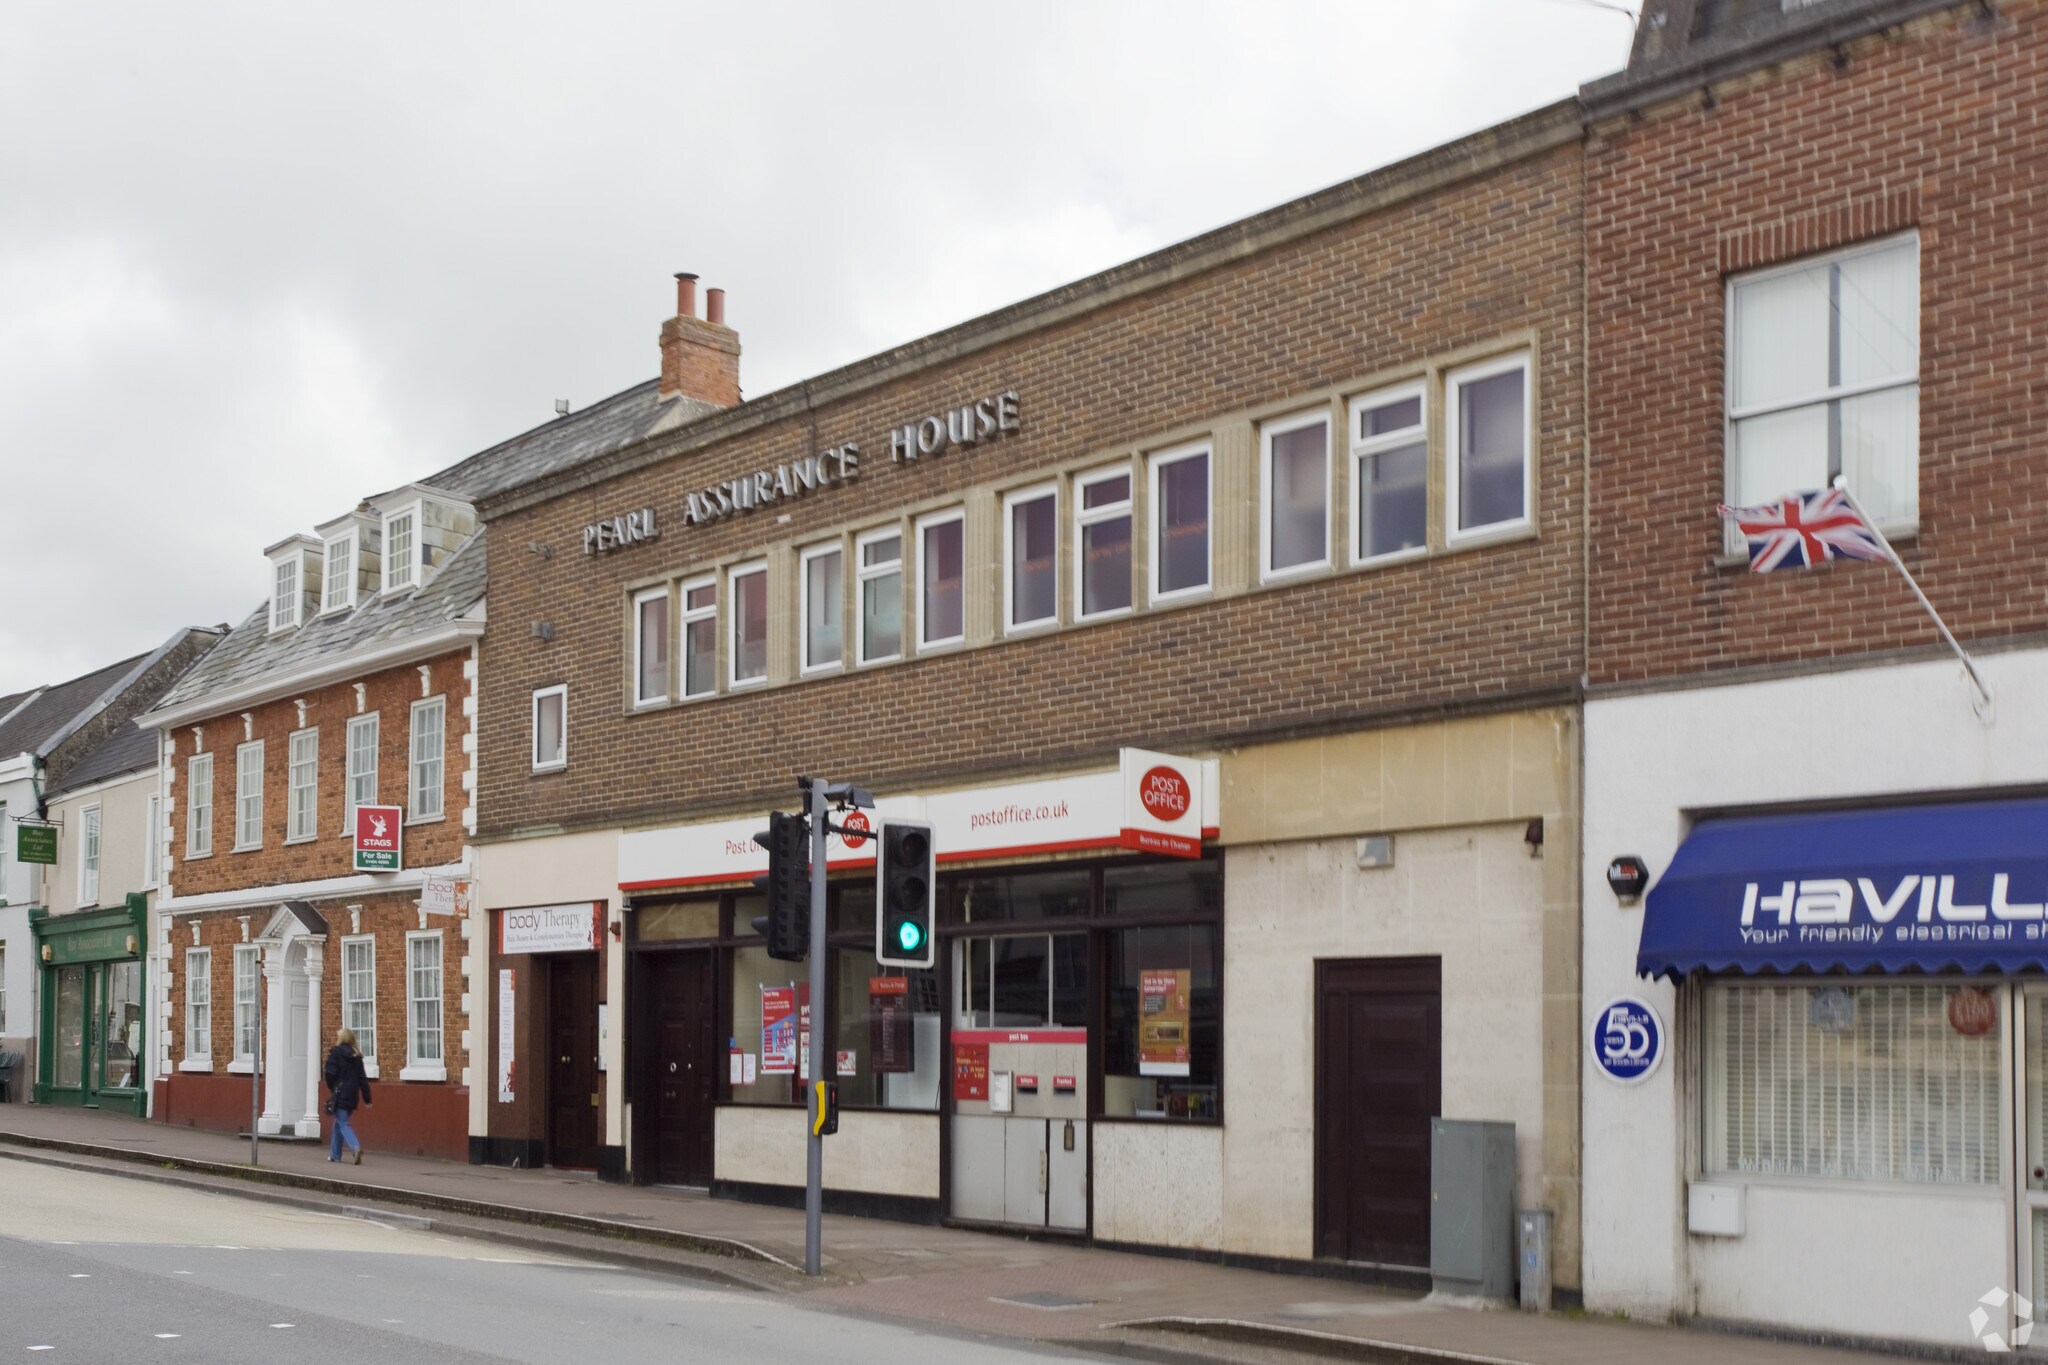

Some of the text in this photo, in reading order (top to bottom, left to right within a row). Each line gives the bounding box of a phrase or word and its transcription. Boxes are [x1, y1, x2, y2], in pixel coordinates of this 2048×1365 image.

[584, 391, 1021, 555] PEARL ASSURANCE HOUSE
[1151, 775, 1181, 794] POST
[1144, 789, 1185, 811] OFFICE
[971, 800, 1069, 831] postoffice.co.uk
[363, 838, 392, 847] STAGS
[725, 839, 747, 856] Post
[1139, 834, 1191, 852] Bureau de Change
[362, 851, 393, 860] For Sale
[1740, 872, 2048, 926] HaVILL
[509, 908, 581, 932] body Therapy
[1740, 926, 1790, 944] Your
[1800, 922, 1884, 944] friendly
[1896, 920, 2013, 942] electrical
[1604, 1007, 1649, 1059] 50
